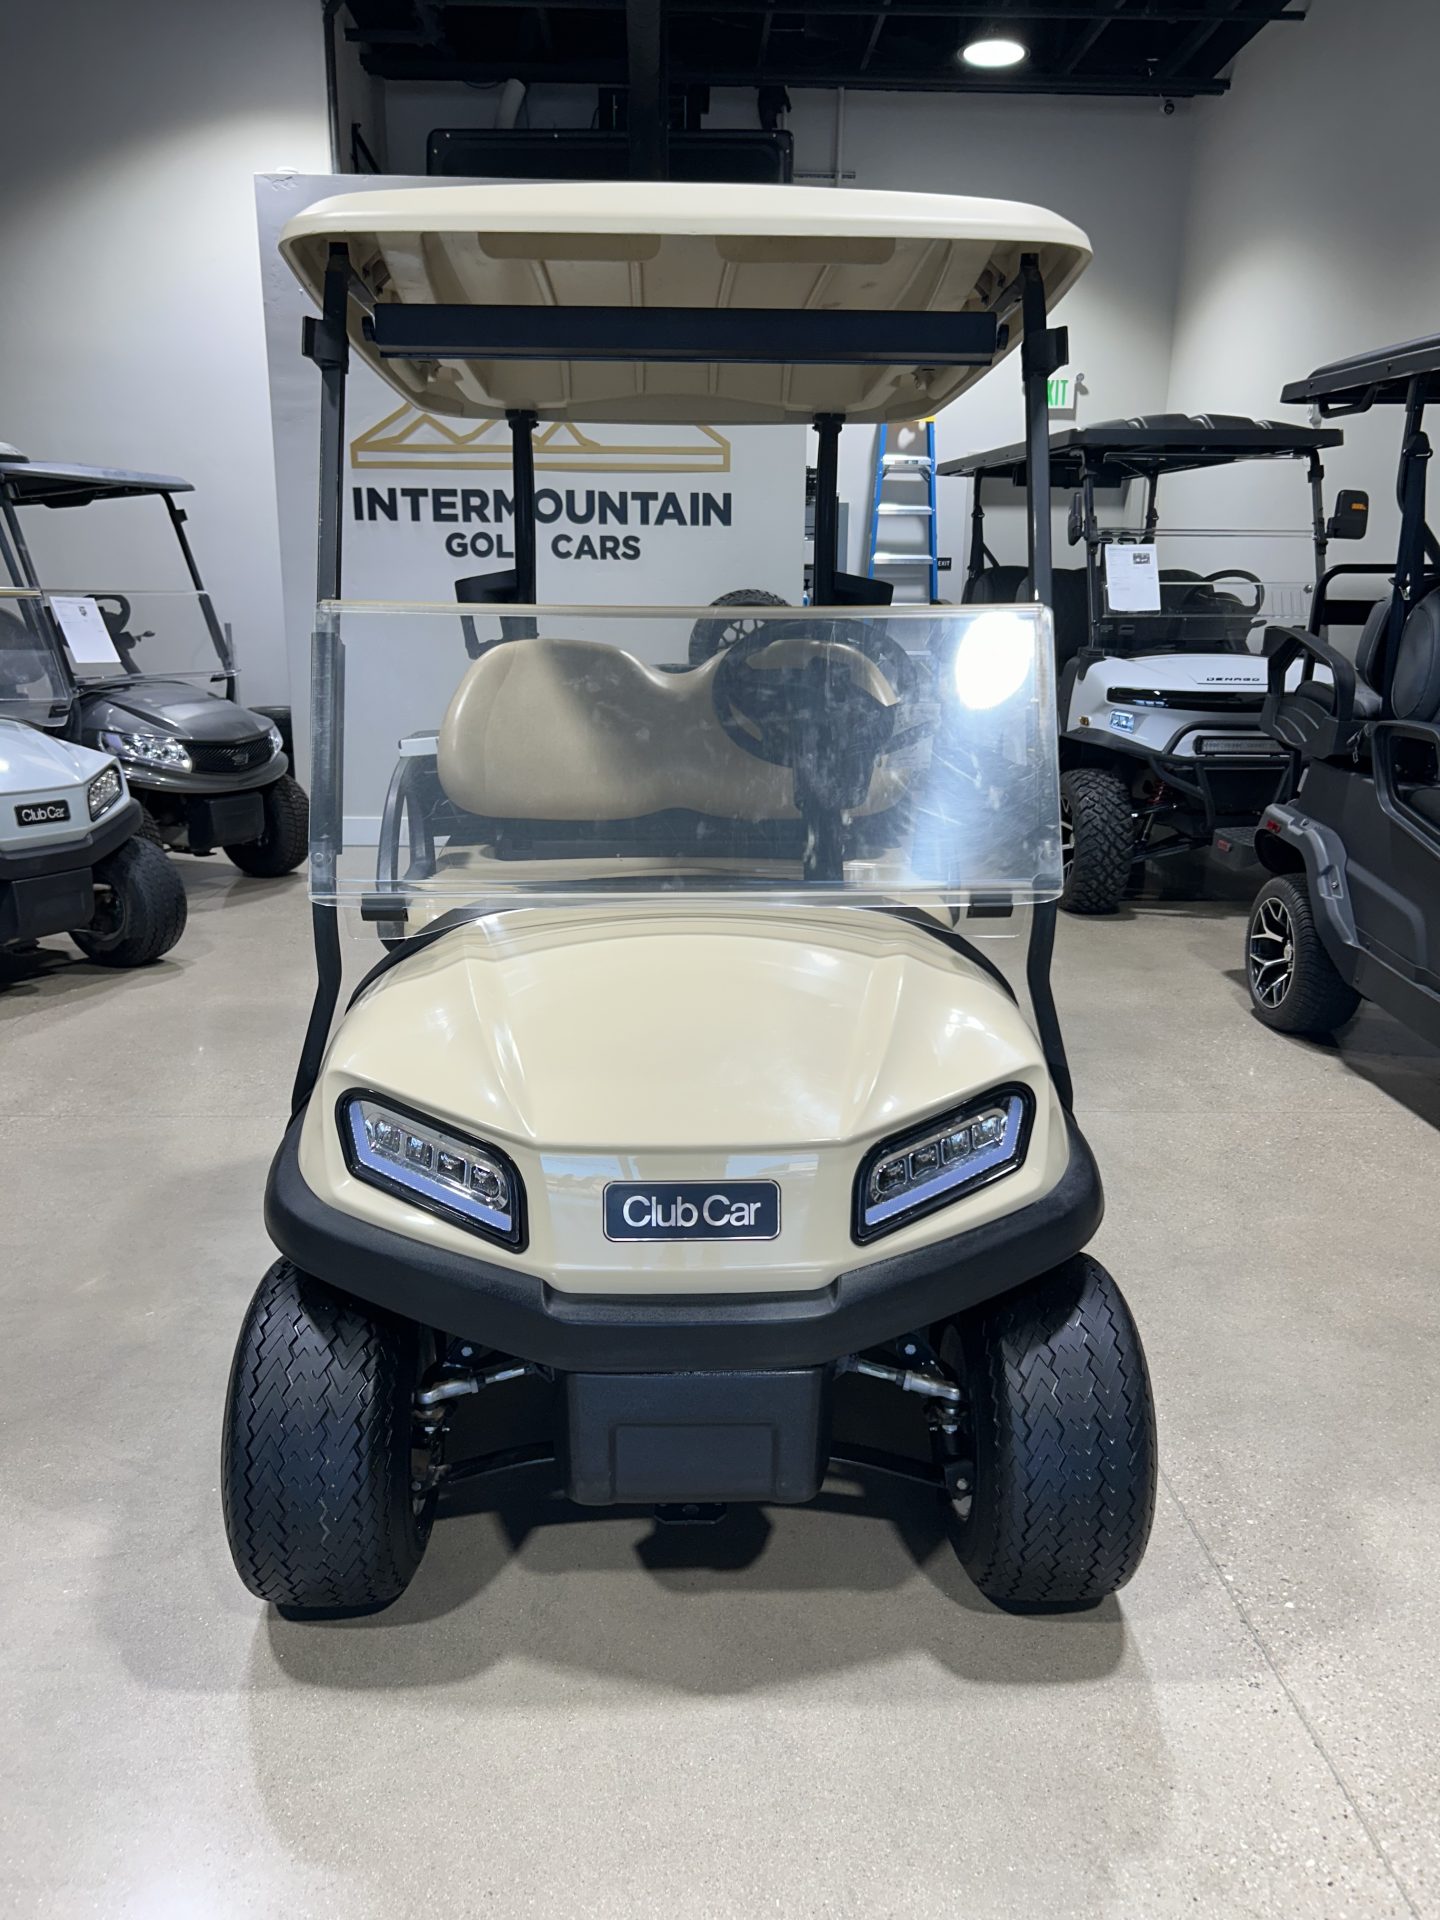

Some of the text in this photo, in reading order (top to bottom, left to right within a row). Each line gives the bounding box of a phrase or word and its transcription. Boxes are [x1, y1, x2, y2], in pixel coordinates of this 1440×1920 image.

[1047, 379, 1069, 406] XIT
[352, 487, 732, 526] INTERMOUNTAIN
[445, 531, 641, 560] GOL CARS
[21, 806, 65, 821] Club Car
[622, 1194, 762, 1228] Club Car
